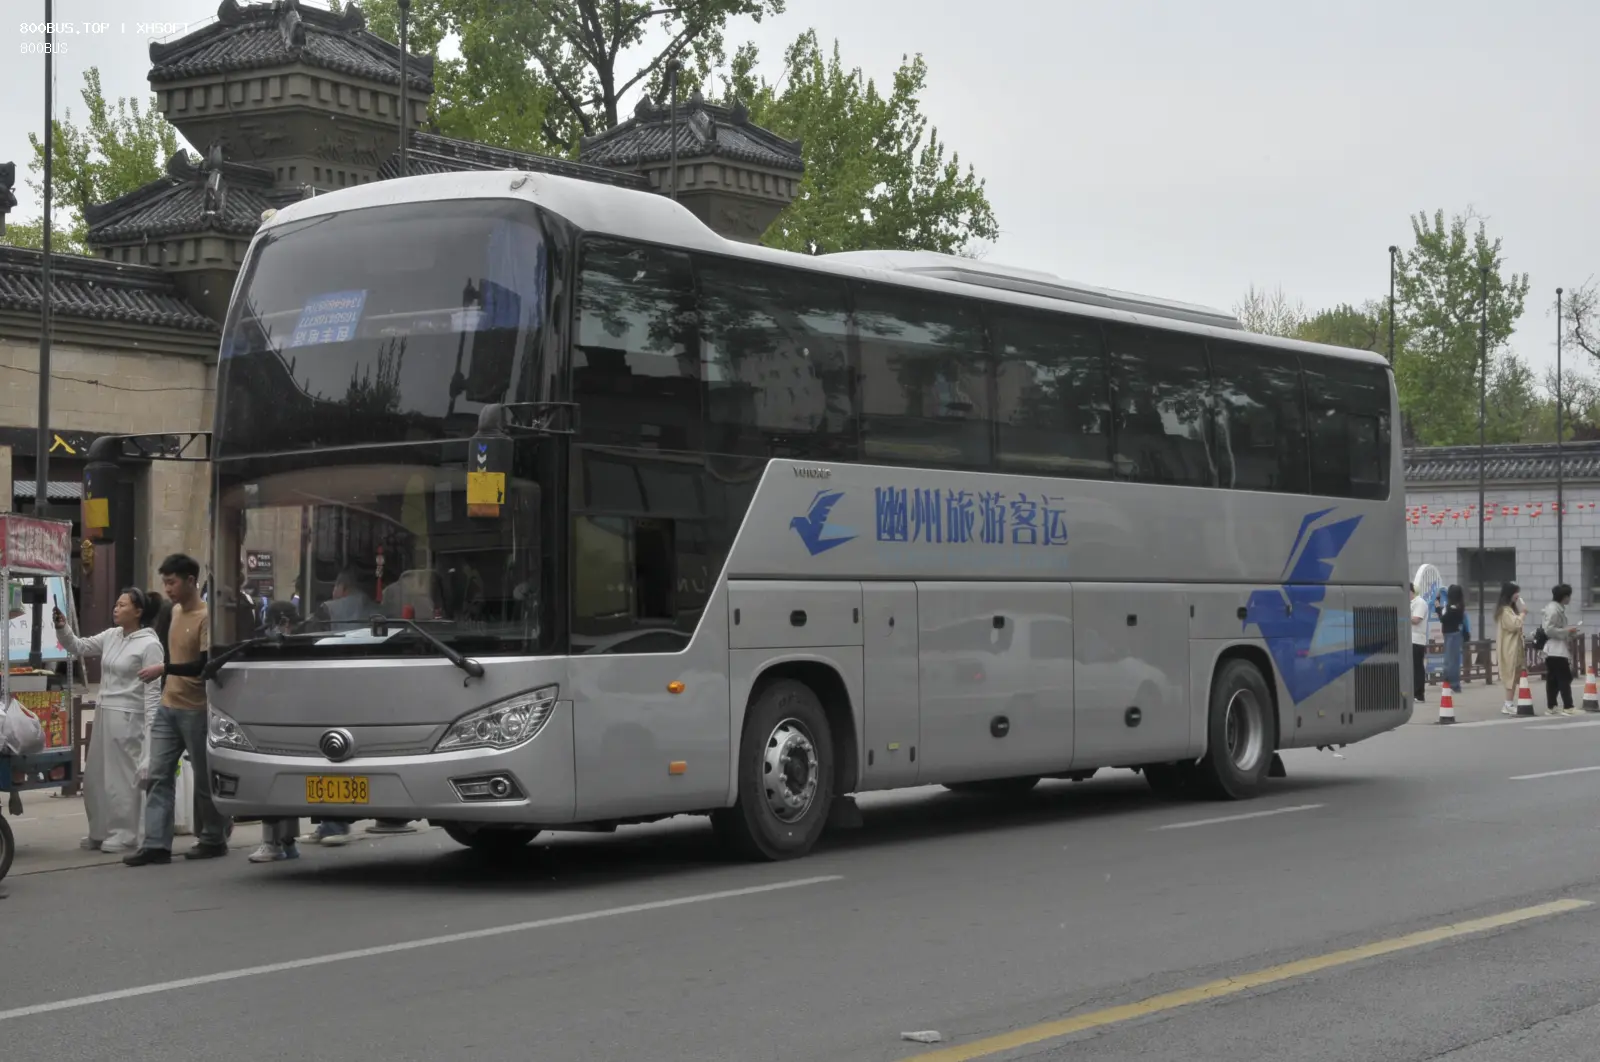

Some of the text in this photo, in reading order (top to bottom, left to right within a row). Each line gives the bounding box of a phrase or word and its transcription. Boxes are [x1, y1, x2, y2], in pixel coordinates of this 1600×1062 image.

[875, 486, 1069, 546] 幽州旅游客运
